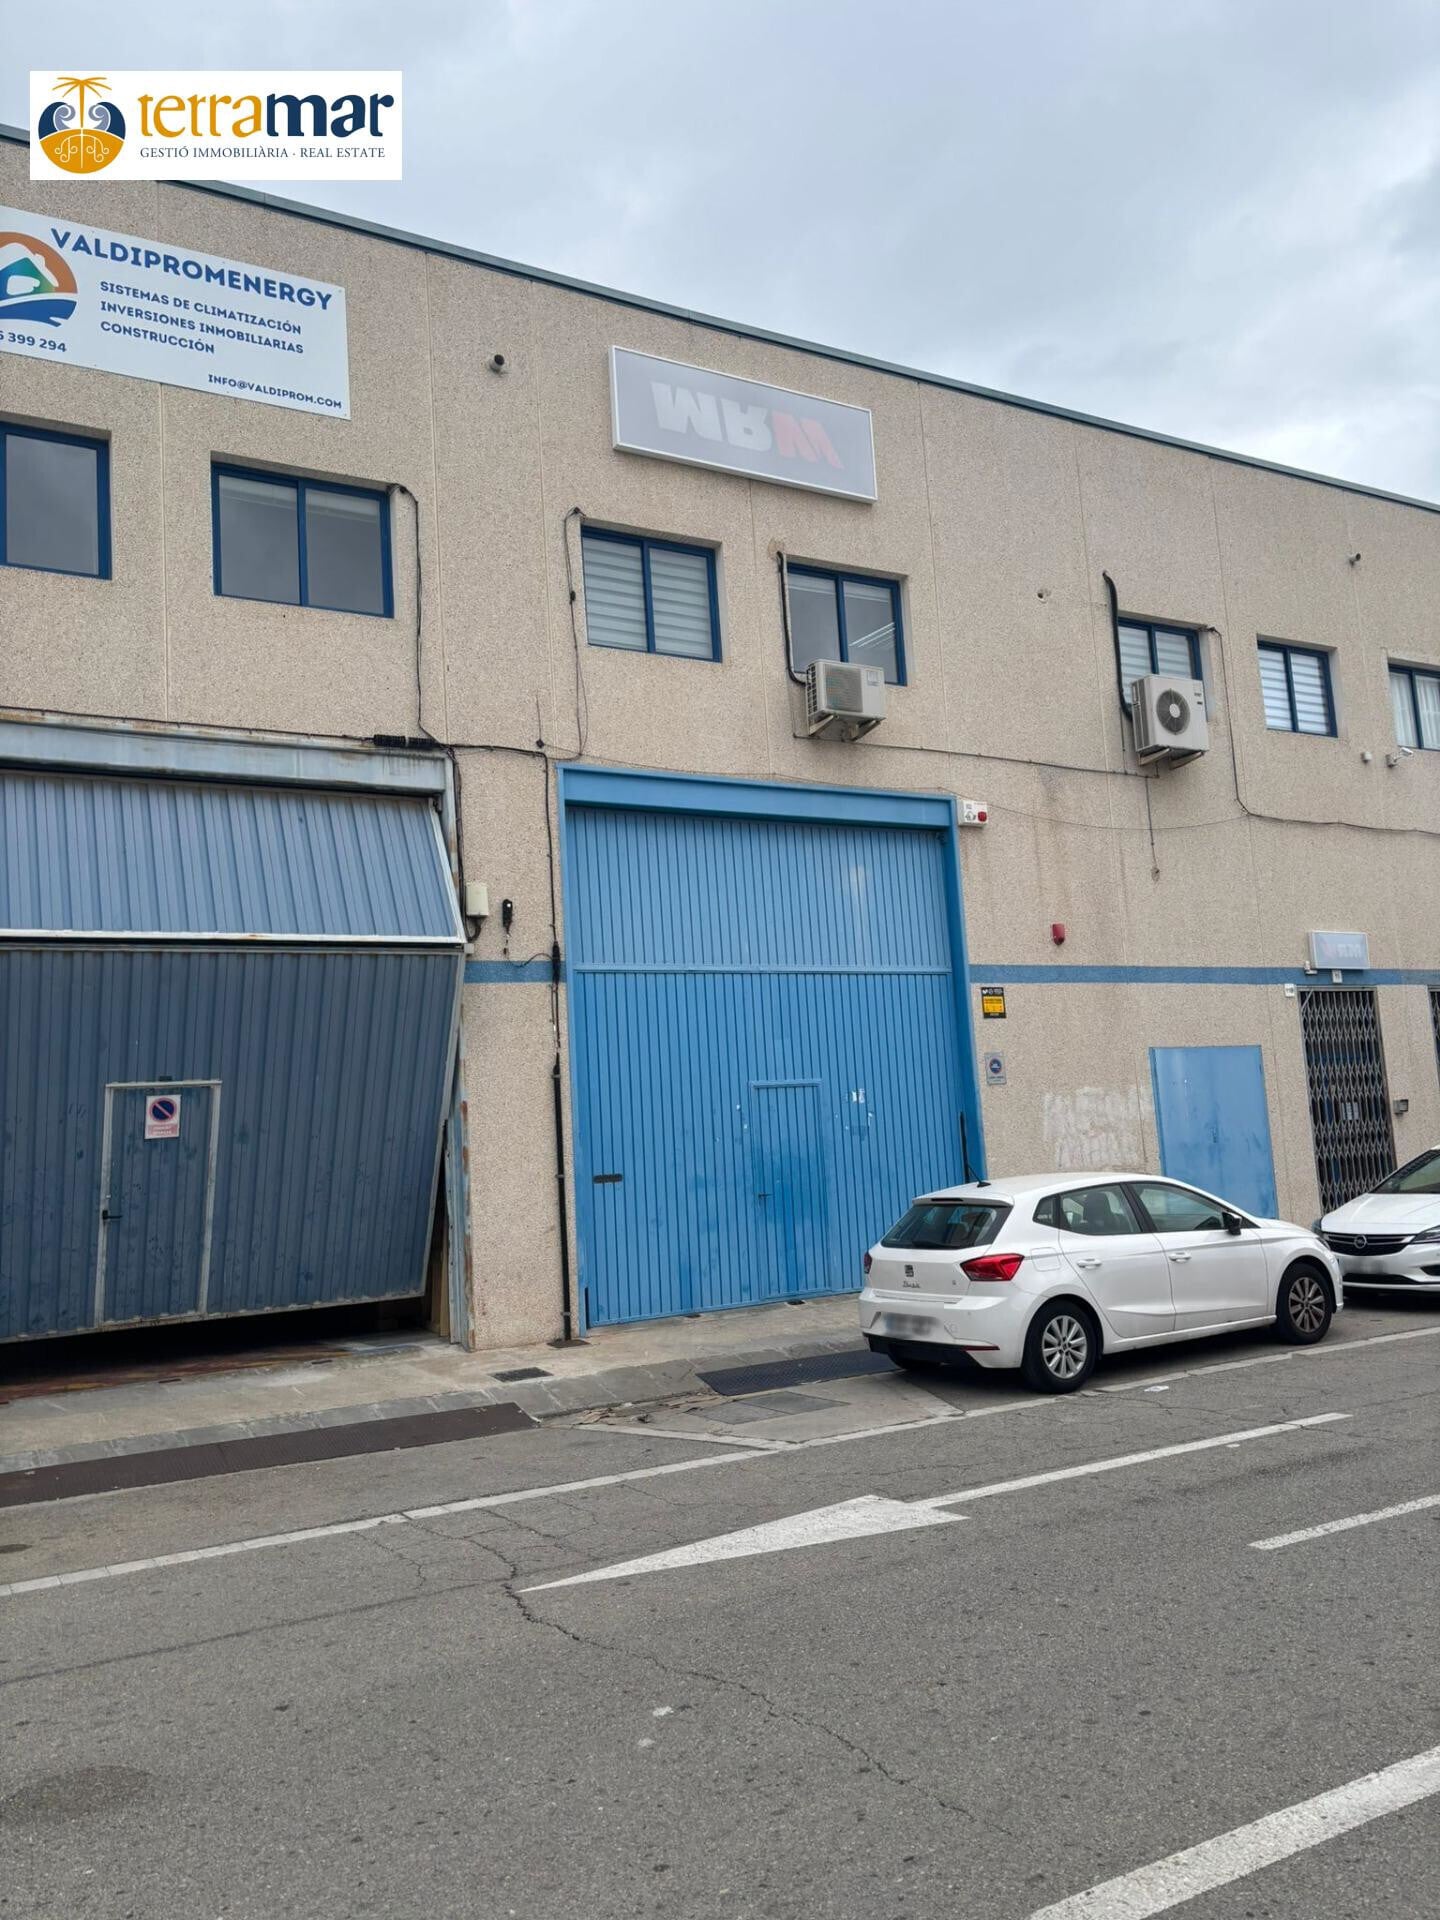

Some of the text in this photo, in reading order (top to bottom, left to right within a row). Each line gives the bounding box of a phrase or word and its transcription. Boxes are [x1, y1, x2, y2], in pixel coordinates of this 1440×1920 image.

[51, 228, 332, 310] VALDIPROMENERGY
[100, 281, 301, 335] SISTEMAS DE CLIMATIZACIÓN
[100, 301, 304, 354] INVERSIONES INMOBILIARIAS
[8, 332, 35, 346] 399
[39, 338, 67, 352] 294
[100, 321, 215, 354] CONSTRUCCIÓN
[208, 374, 342, 409] INFO@VALDIPROM.COM
